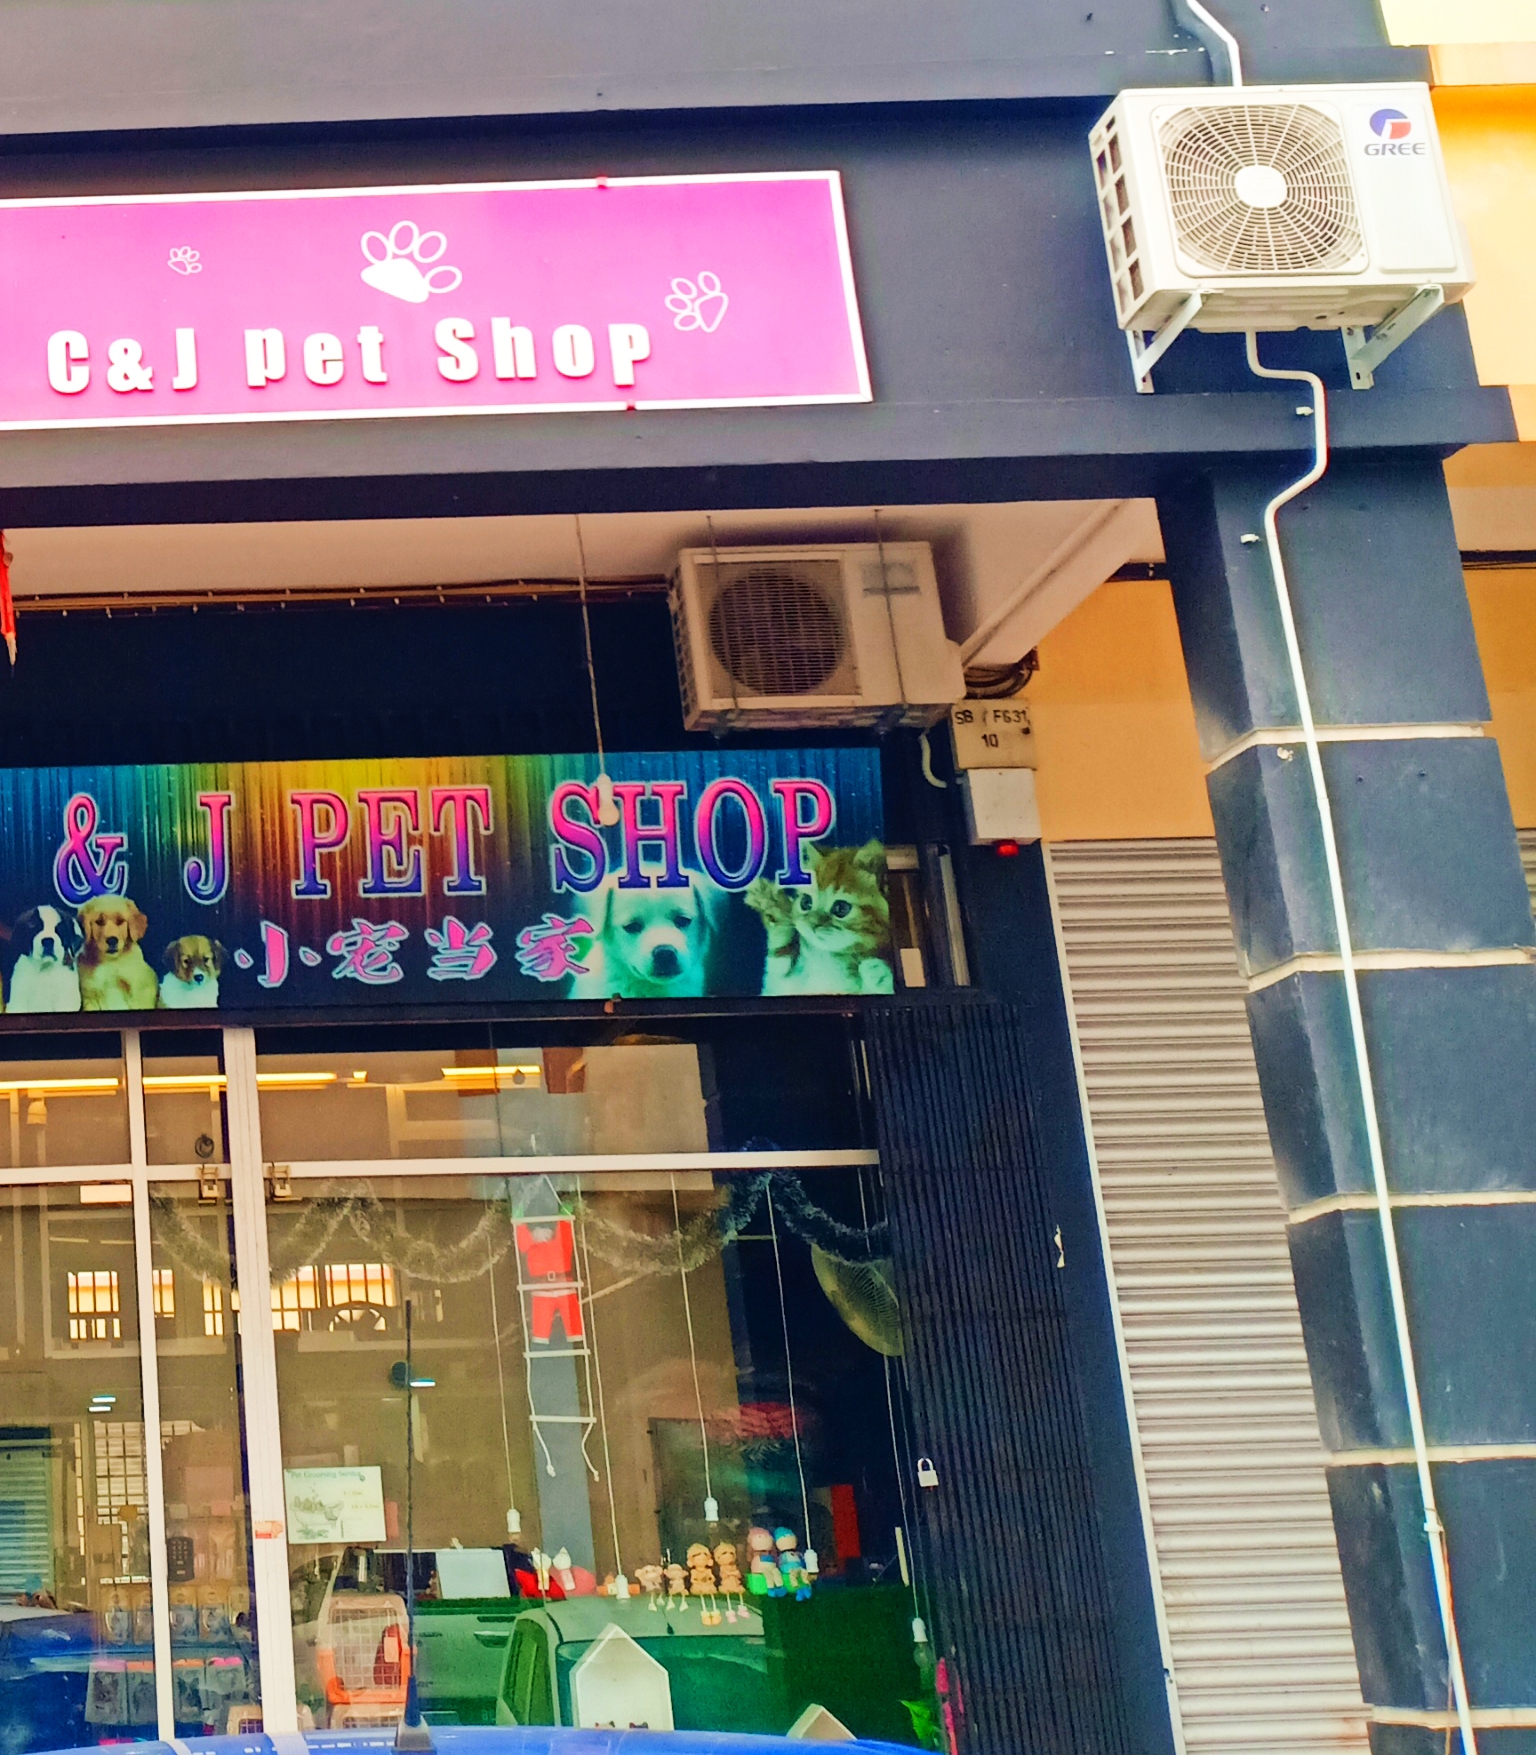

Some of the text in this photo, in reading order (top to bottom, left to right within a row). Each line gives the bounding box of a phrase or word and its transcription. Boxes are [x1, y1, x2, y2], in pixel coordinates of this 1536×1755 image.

[1364, 142, 1426, 157] GREE
[244, 324, 390, 389] pet
[434, 316, 652, 387] Shop
[52, 791, 126, 907] &
[182, 791, 233, 905] J
[289, 786, 493, 899] PET
[548, 777, 838, 894] SHOP
[232, 913, 596, 989] 小宠当家
